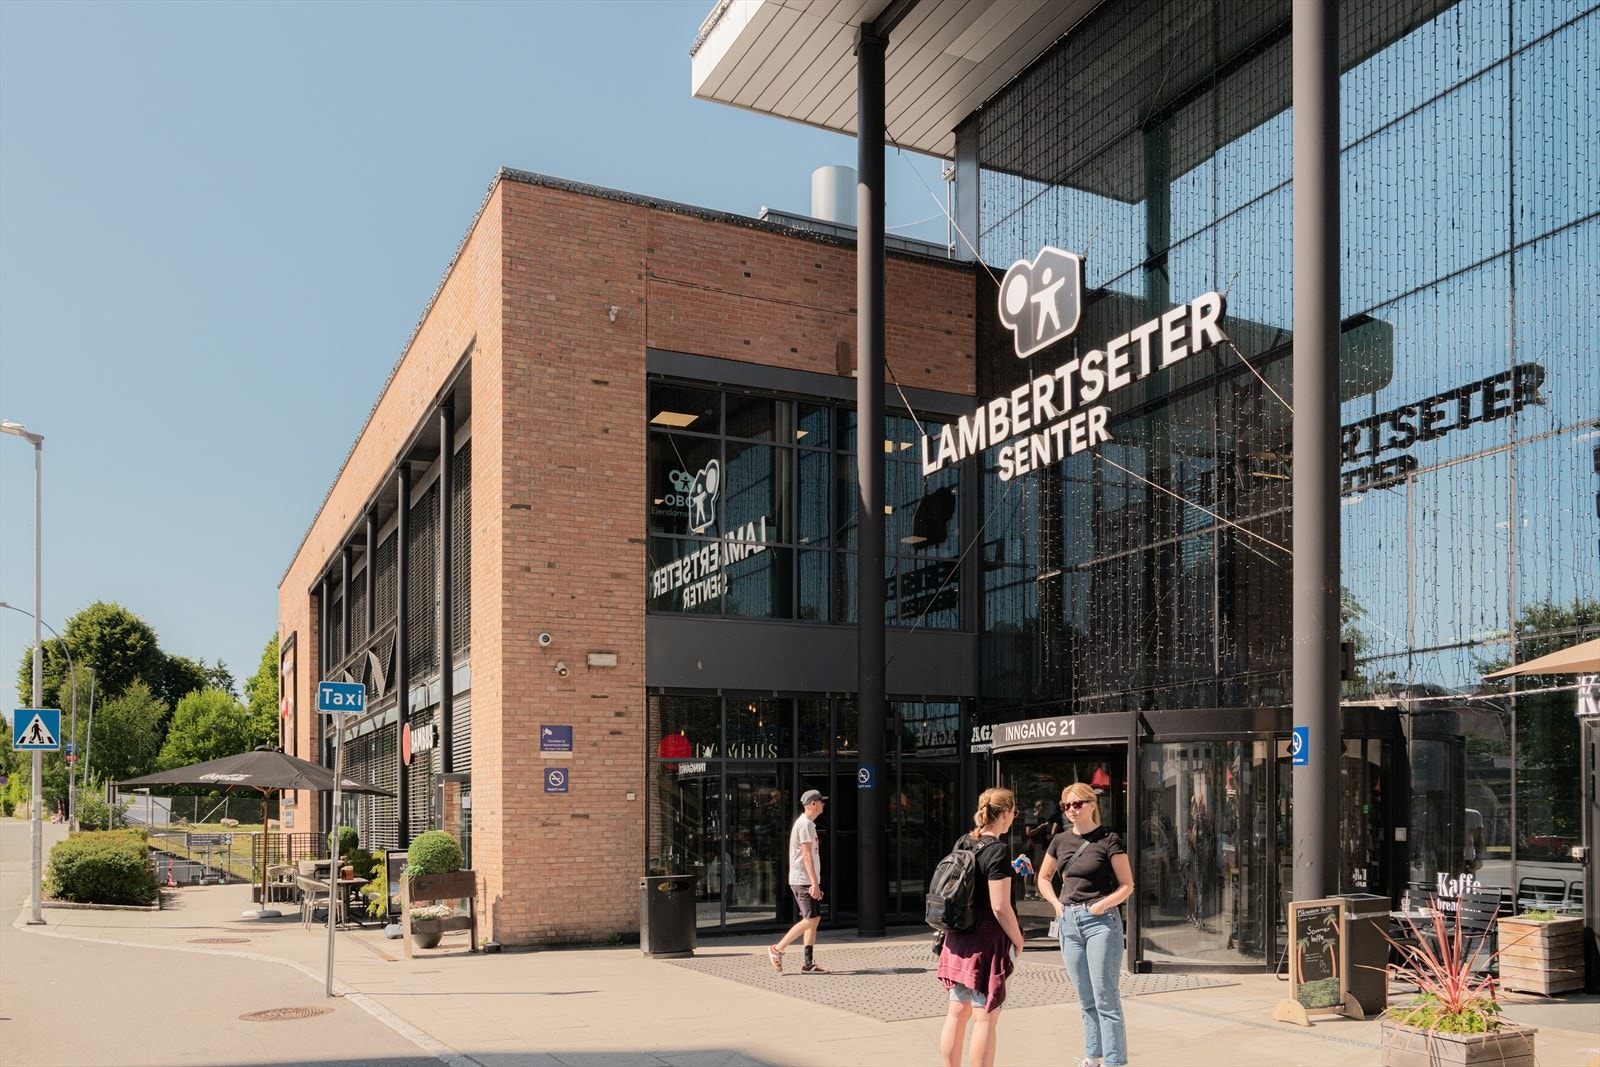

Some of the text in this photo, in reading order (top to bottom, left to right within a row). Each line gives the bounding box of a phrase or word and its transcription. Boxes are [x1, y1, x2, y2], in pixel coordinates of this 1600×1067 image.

[922, 291, 1227, 476] LAMBERTSETER
[999, 405, 1112, 481] SENTER
[322, 688, 362, 706] Taxi
[1006, 722, 1056, 741] INNGANG
[1059, 720, 1075, 735] 21
[1436, 872, 1482, 898] Kaffe
